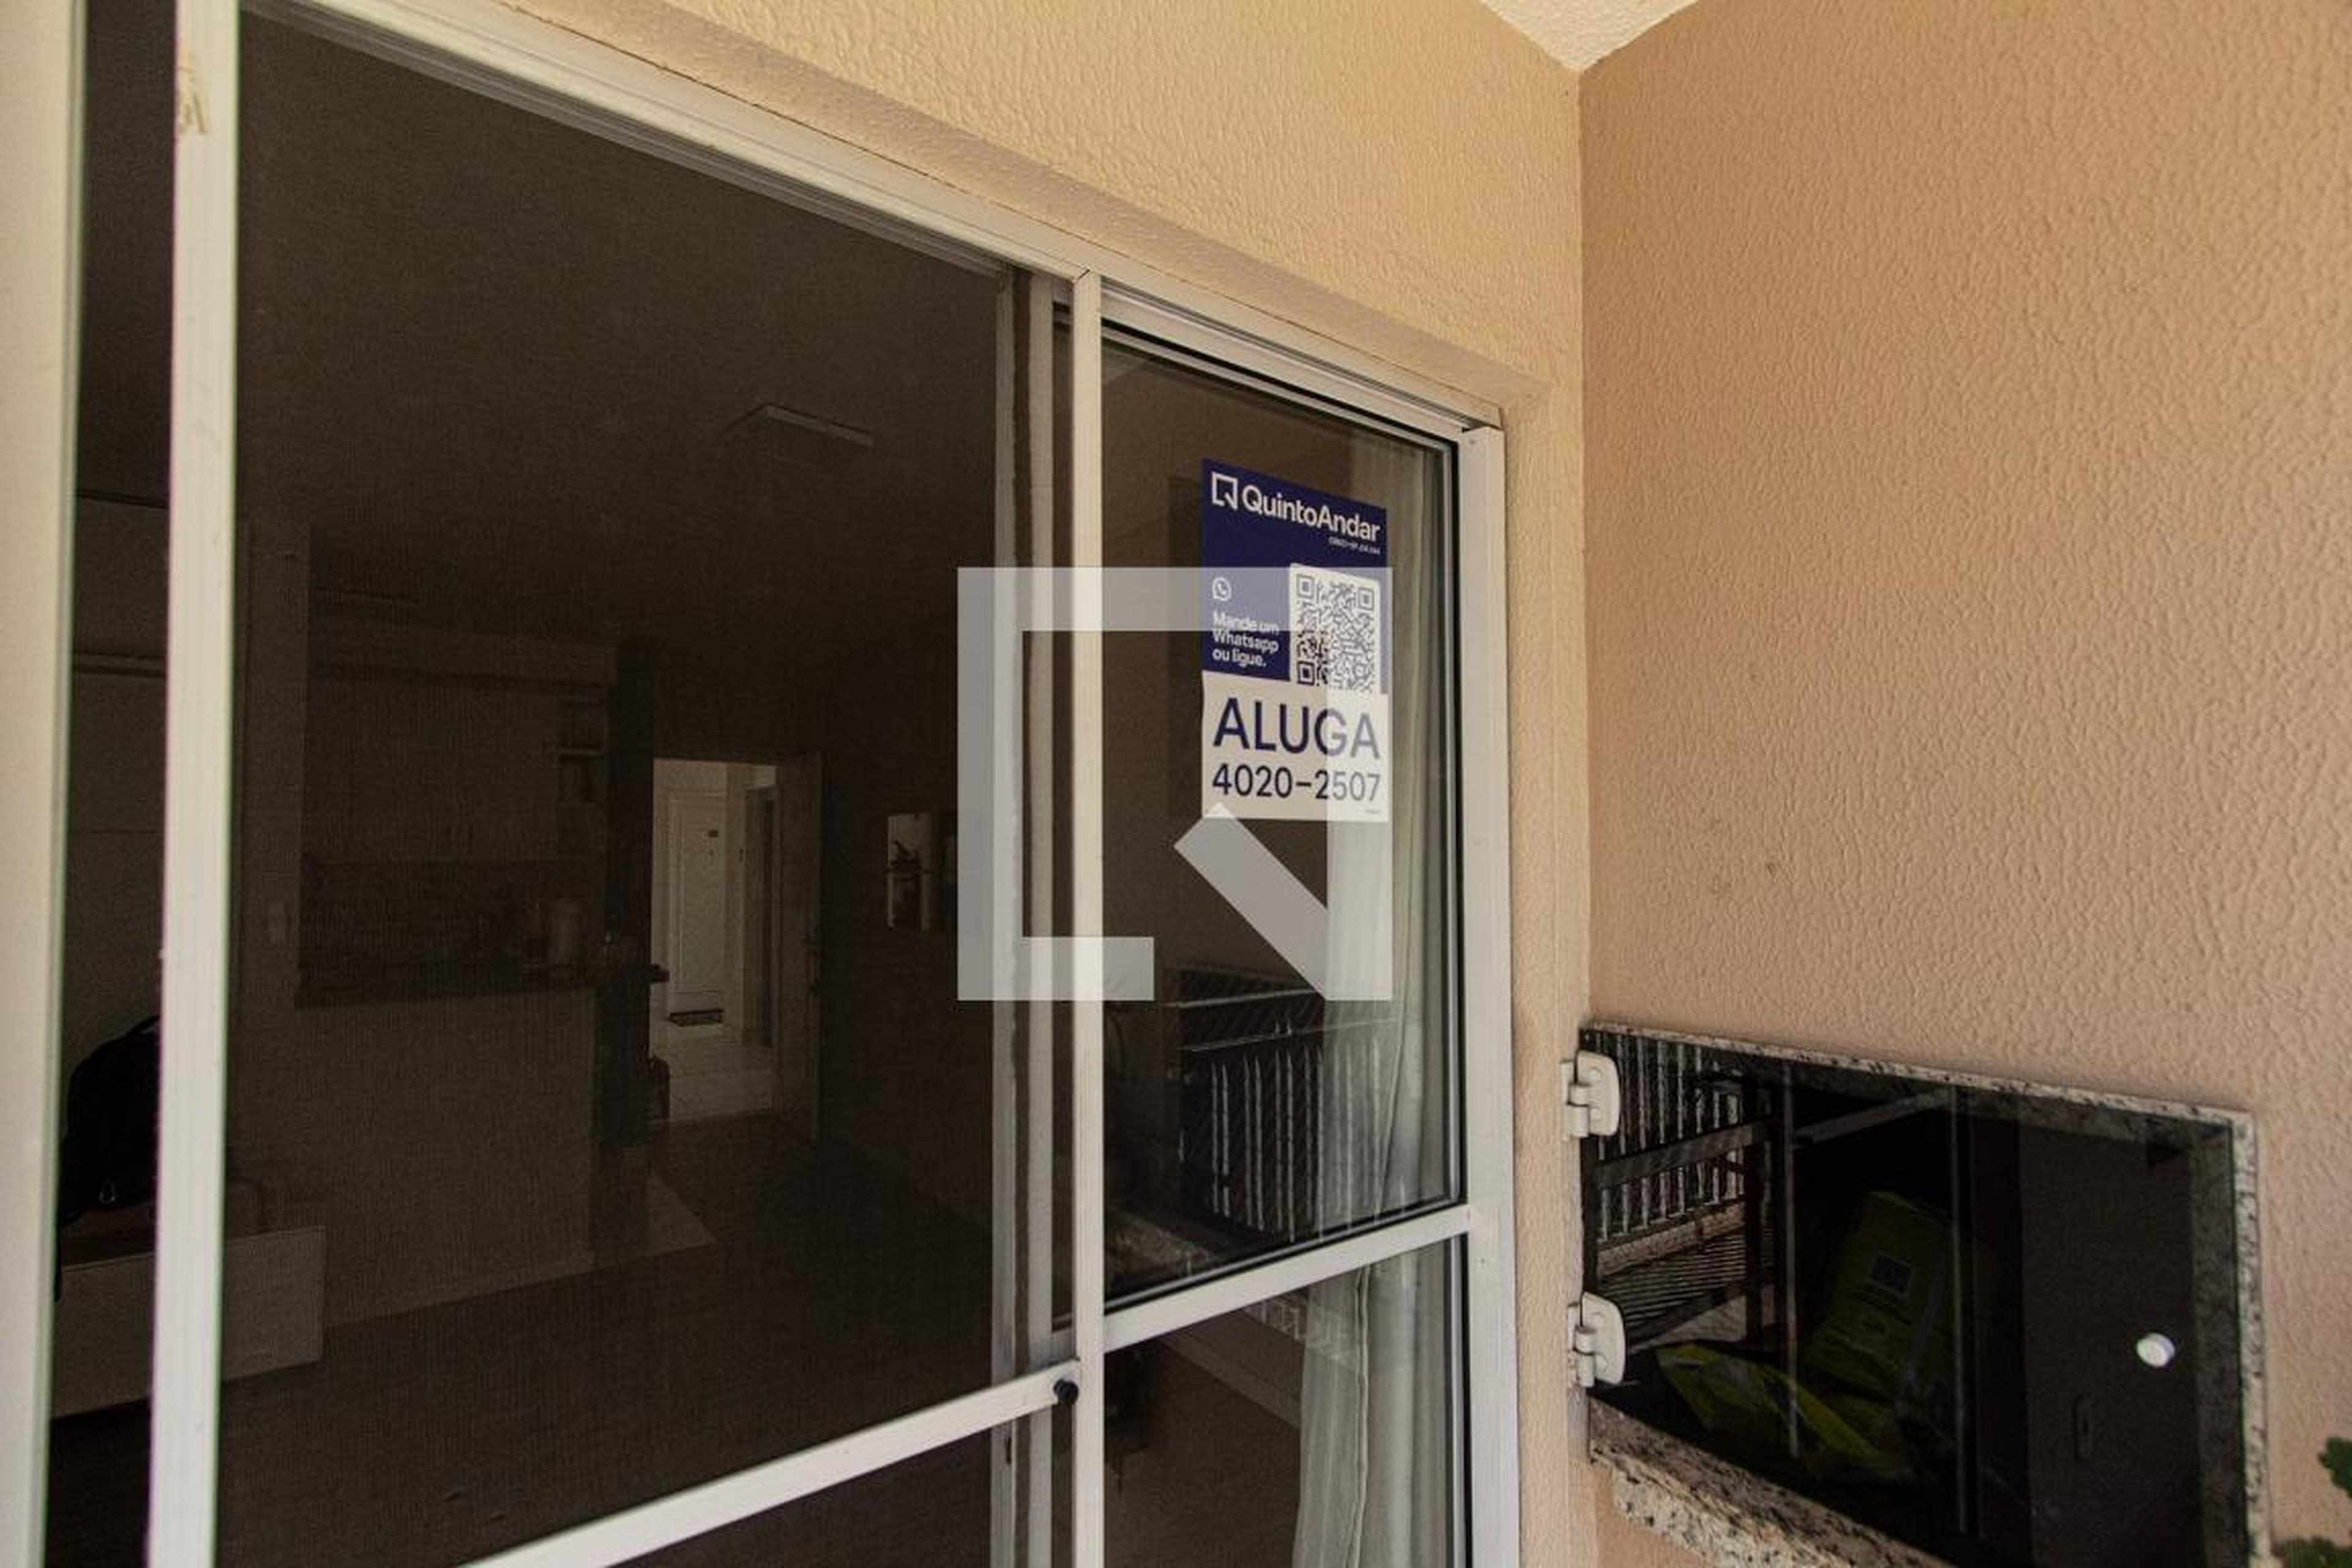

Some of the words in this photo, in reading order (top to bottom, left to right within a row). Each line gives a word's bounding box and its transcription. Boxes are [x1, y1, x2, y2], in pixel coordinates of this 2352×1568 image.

[1242, 484, 1381, 541] QuintoAndar
[1213, 611, 1258, 631] Mande
[1259, 622, 1279, 635] um
[1212, 628, 1279, 655] Whatsapp
[1212, 648, 1230, 662] ou
[1232, 647, 1267, 668] ligue.
[1213, 697, 1380, 760] ALUGA
[1212, 763, 1381, 801] 4020-2507
